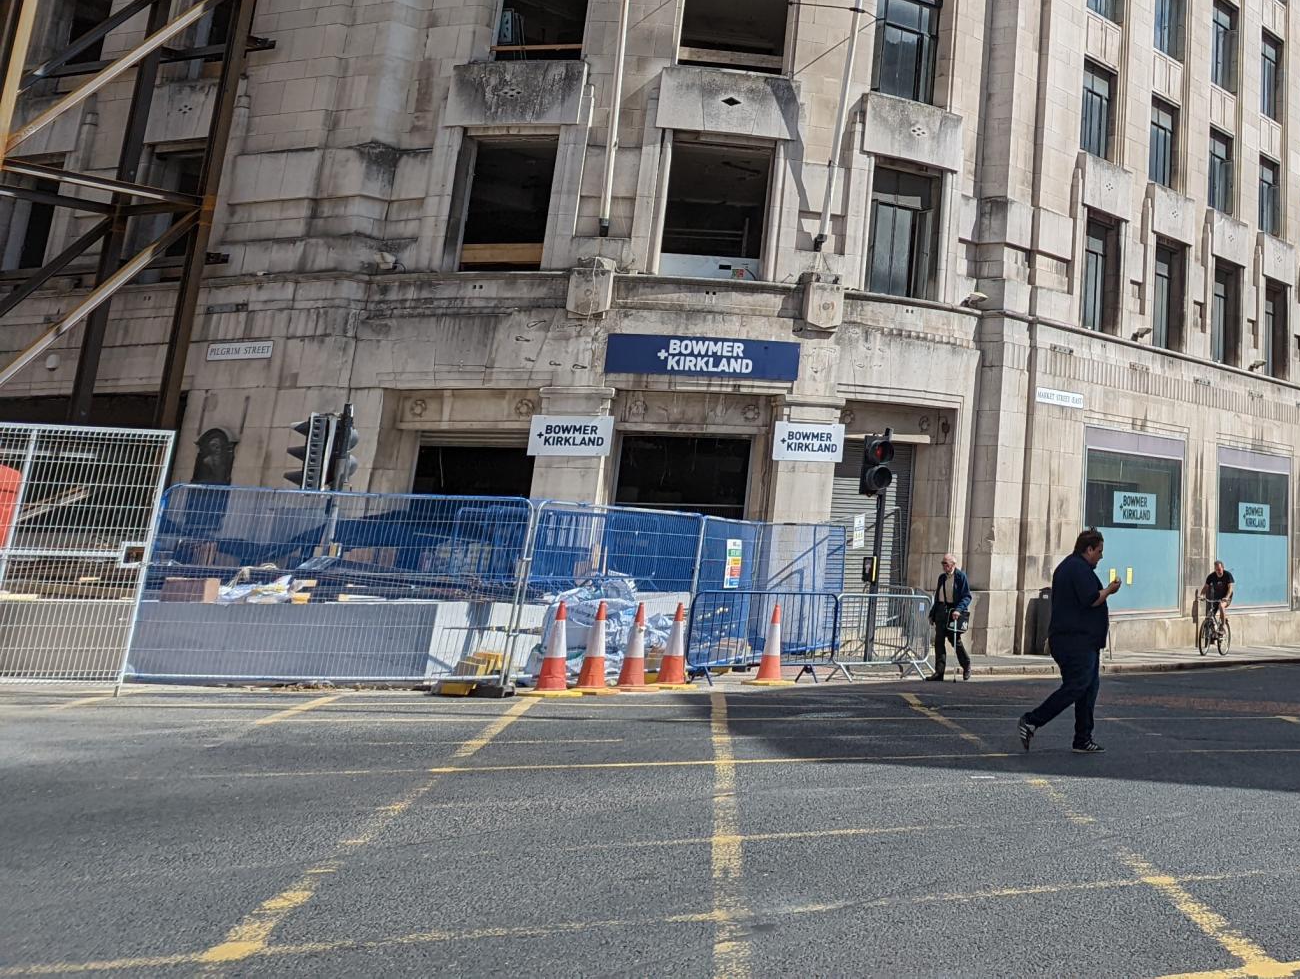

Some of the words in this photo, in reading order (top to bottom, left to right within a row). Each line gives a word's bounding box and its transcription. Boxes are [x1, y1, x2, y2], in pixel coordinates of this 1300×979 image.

[209, 347, 240, 356] PILGRIM
[244, 346, 271, 354] STREET
[668, 339, 744, 357] BOWMER
[666, 355, 753, 374] KIRKLAND
[1037, 391, 1055, 400] MARKET
[545, 424, 598, 435] BOWMER
[543, 435, 604, 447] KIRKLAND
[786, 431, 832, 442] BOWMER
[785, 439, 838, 453] KIRKLAND
[1123, 495, 1148, 507] BOWMER
[1122, 508, 1151, 521] KIRKLAND
[1245, 506, 1264, 517] BOWMER
[1244, 517, 1266, 529] KIRKLAND
